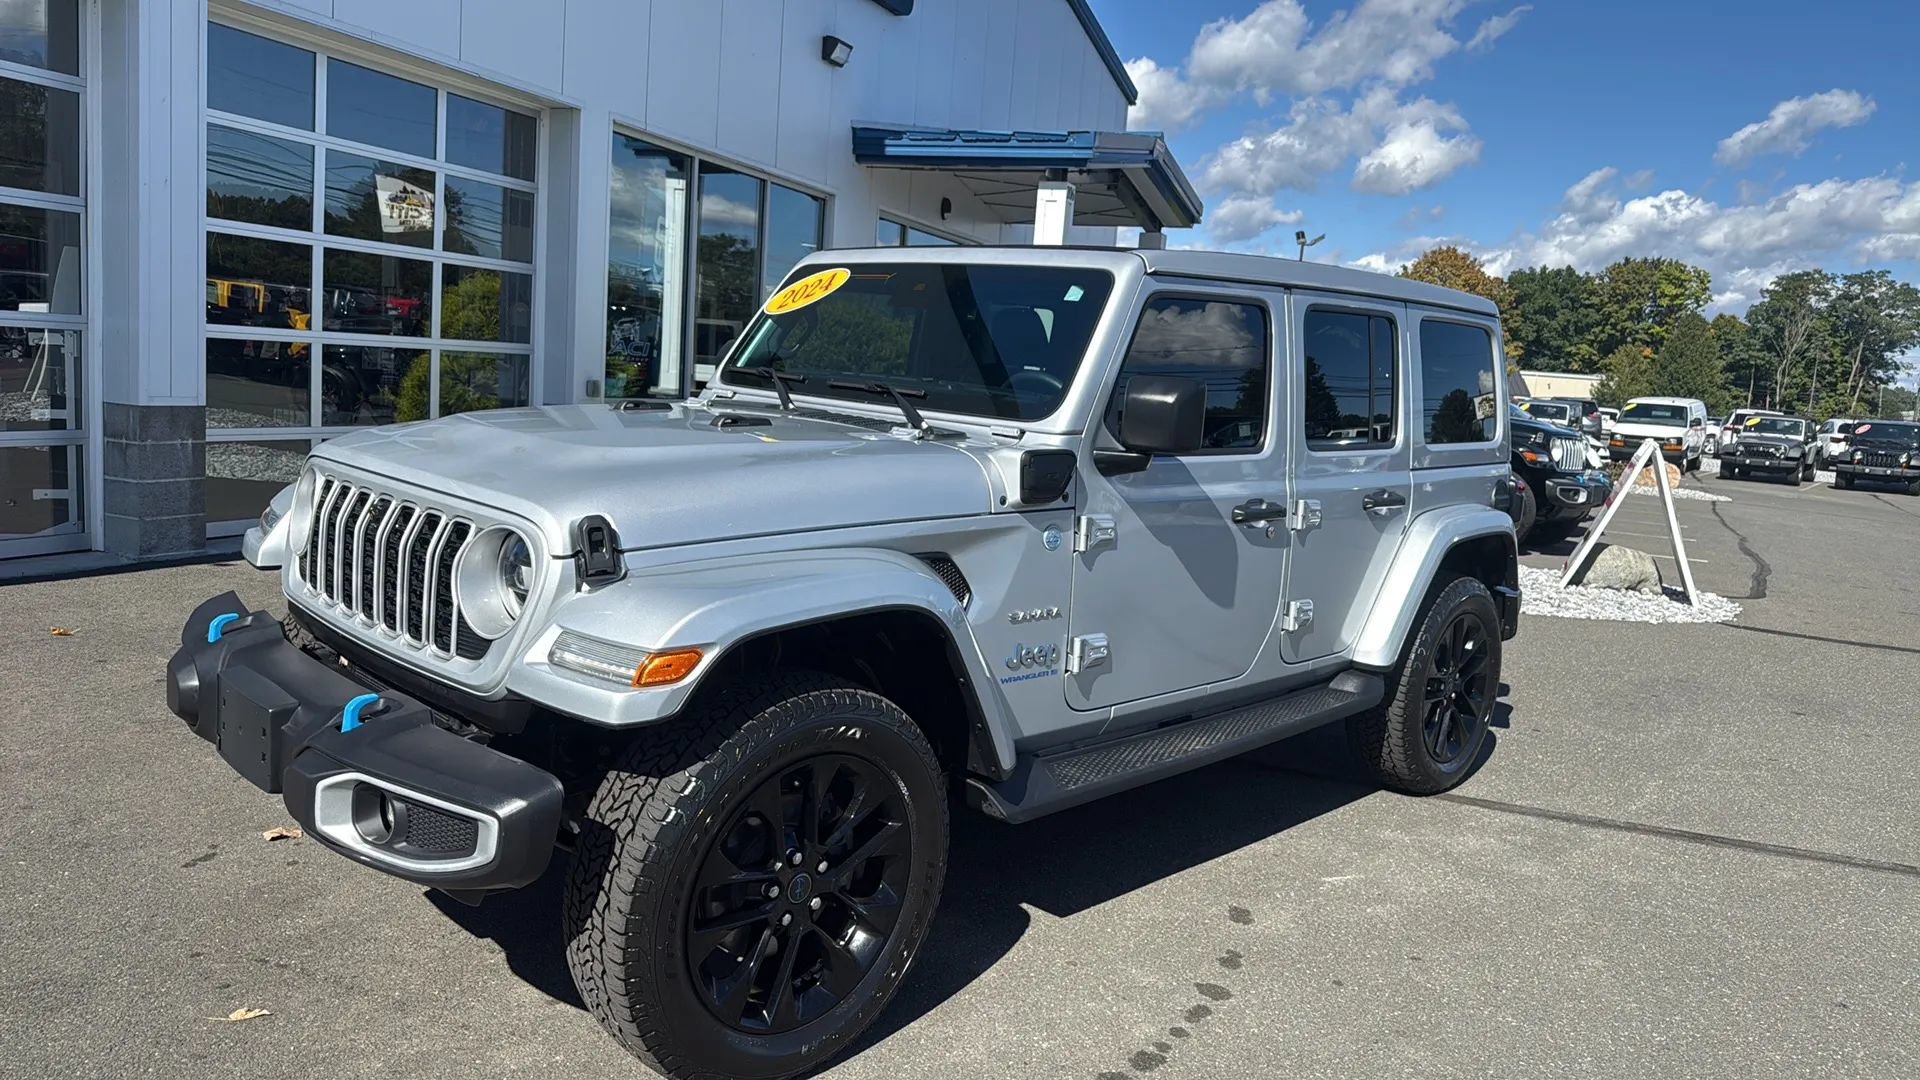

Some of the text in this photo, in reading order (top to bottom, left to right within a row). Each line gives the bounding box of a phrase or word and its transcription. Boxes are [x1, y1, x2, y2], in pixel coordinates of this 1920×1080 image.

[777, 272, 839, 310] 2024
[608, 340, 651, 357] ACI
[1008, 607, 1063, 624] SAHARA
[1004, 642, 1060, 671] Jeep
[1000, 670, 1049, 685] WRANGLER
